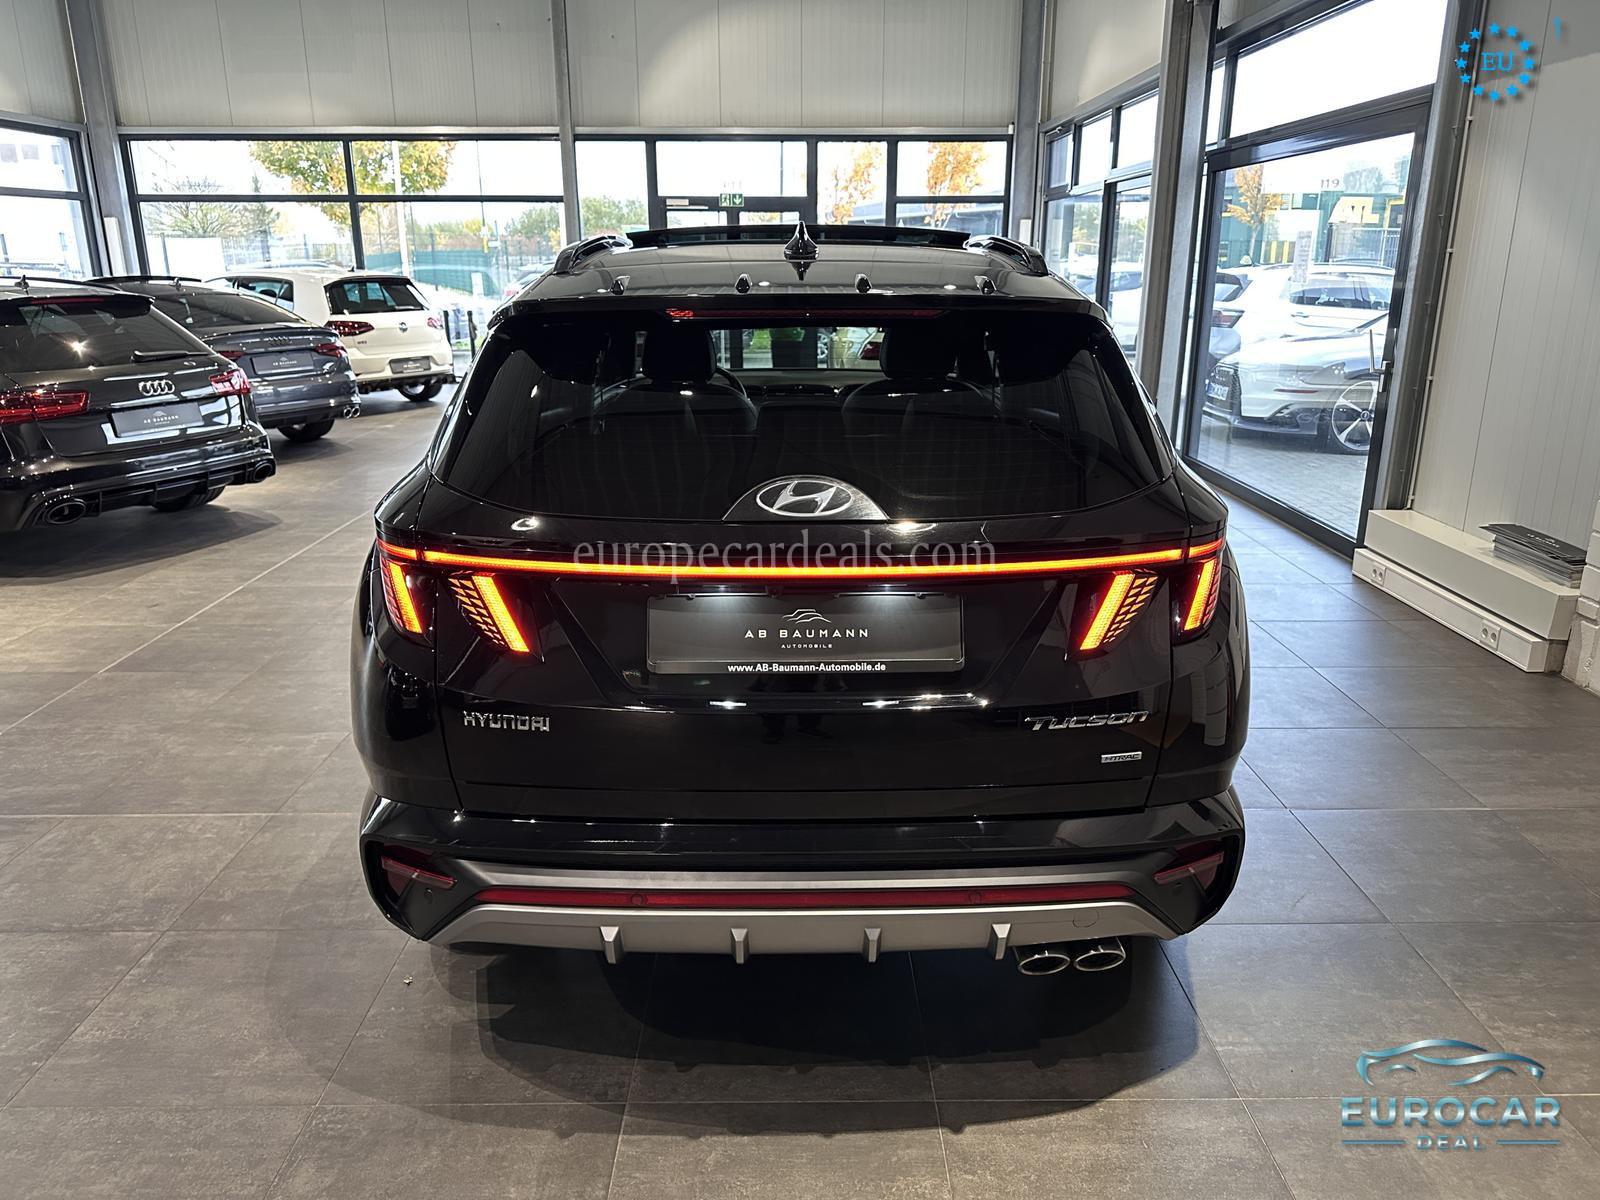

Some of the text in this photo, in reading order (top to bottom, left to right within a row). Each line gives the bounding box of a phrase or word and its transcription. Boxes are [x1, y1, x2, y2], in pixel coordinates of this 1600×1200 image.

[744, 628, 868, 639] AB BAUMANN
[727, 662, 886, 673] www.AB-Baumann-Automobile.de
[462, 710, 550, 732] HYUNDAI
